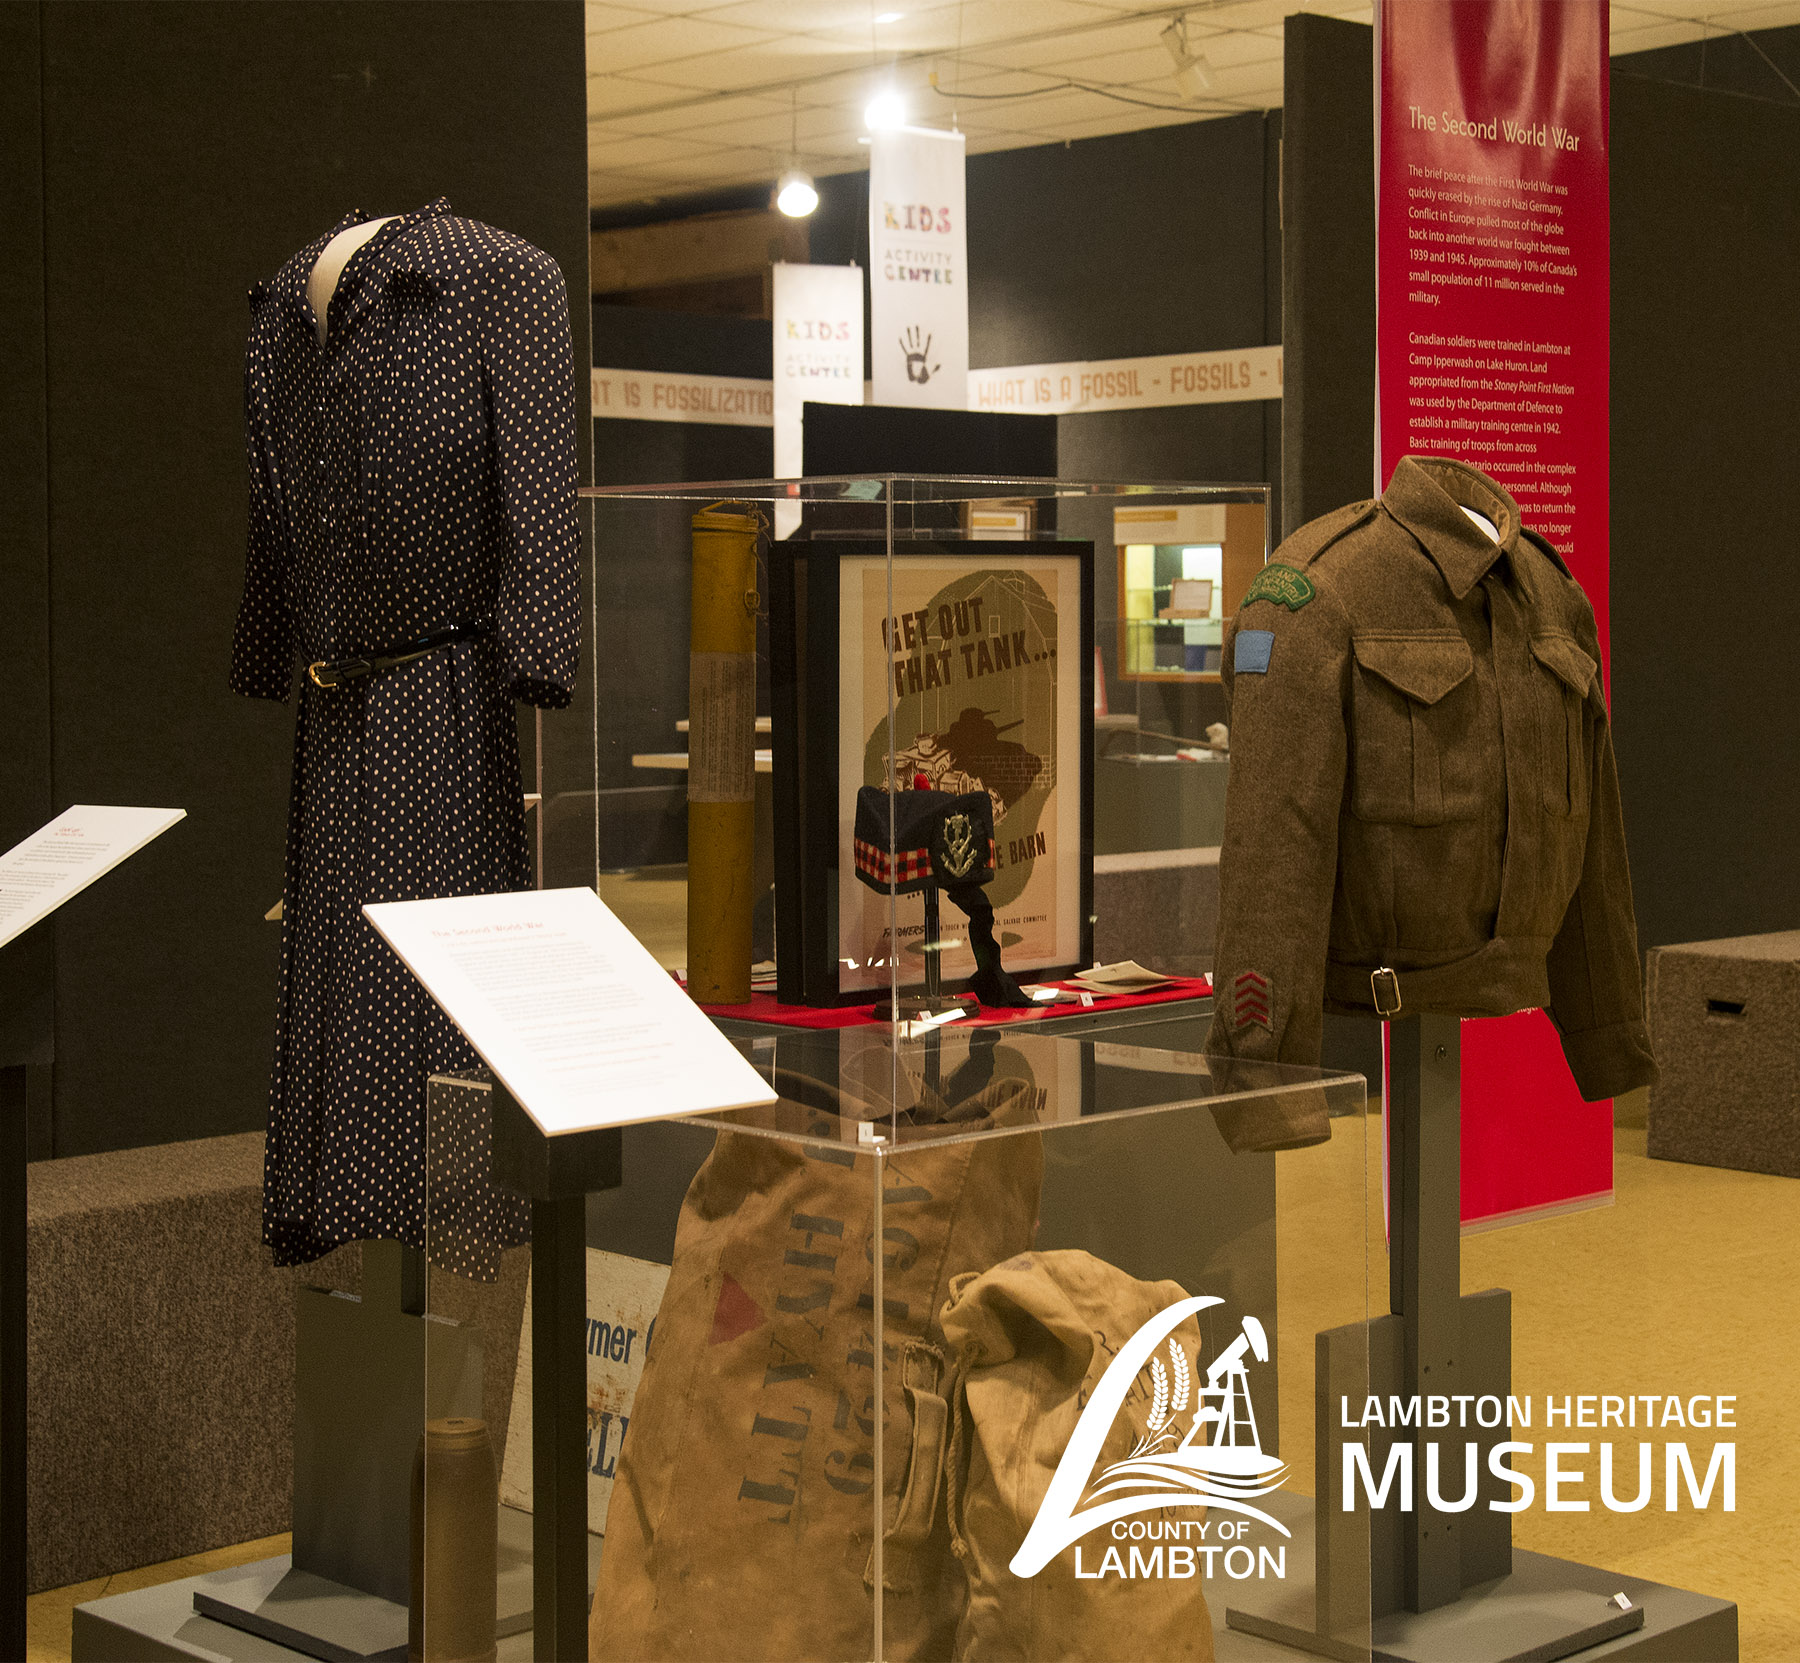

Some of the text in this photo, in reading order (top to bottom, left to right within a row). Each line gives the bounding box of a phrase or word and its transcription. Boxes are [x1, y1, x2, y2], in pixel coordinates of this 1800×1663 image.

[1409, 105, 1579, 151] The Second World War
[1409, 164, 1568, 195] The brief peace after the First World War was
[1409, 187, 1563, 217] quickly erased by the rise of Nazi Germany.
[884, 202, 952, 234] KIDS
[1409, 206, 1564, 236] Conflict in Europe pulled most of the globe
[1409, 227, 1570, 256] back into another world war fought between
[884, 249, 952, 264] ACTIVITY
[1410, 249, 1428, 261] 1939
[1430, 252, 1444, 263] and
[1447, 252, 1467, 265] 1945.
[1469, 255, 1522, 272] Approximately
[1524, 260, 1539, 272] 10%
[1540, 261, 1548, 273] of
[1409, 270, 1564, 295] small population of 11 million served in the
[1409, 291, 1440, 306] military.
[786, 319, 850, 341] KIDS
[1409, 332, 1570, 355] Canadian soldiers were trained in Lambton at
[1409, 353, 1547, 373] Camp Ipperwash on Lake Huron. Land
[624, 380, 641, 408] IS
[978, 379, 1024, 407] WHAT
[1034, 376, 1051, 404] IS
[1060, 375, 1071, 402] A
[1081, 368, 1143, 400] FOSSIL
[1170, 360, 1250, 394] FOSSILS
[1409, 375, 1574, 395] appropriated from the Stoney Point First Nation
[1409, 396, 1563, 414] was used by the Department of Defence to
[1409, 416, 1561, 434] establish a military training centre in 1942.
[1410, 437, 1536, 454] Basic training of troops from across
[1493, 460, 1525, 473] occurred
[1526, 461, 1533, 473] in
[1534, 461, 1545, 473] the
[1547, 462, 1576, 475] complex
[1540, 482, 1571, 495] Although
[1534, 503, 1540, 512] to
[1542, 503, 1562, 513] return
[1564, 503, 1575, 514] the
[1539, 524, 1548, 532] no
[1549, 521, 1571, 536] longer
[881, 597, 983, 653] GET OUT
[894, 650, 952, 697] THAT
[1009, 831, 1047, 866] BARN
